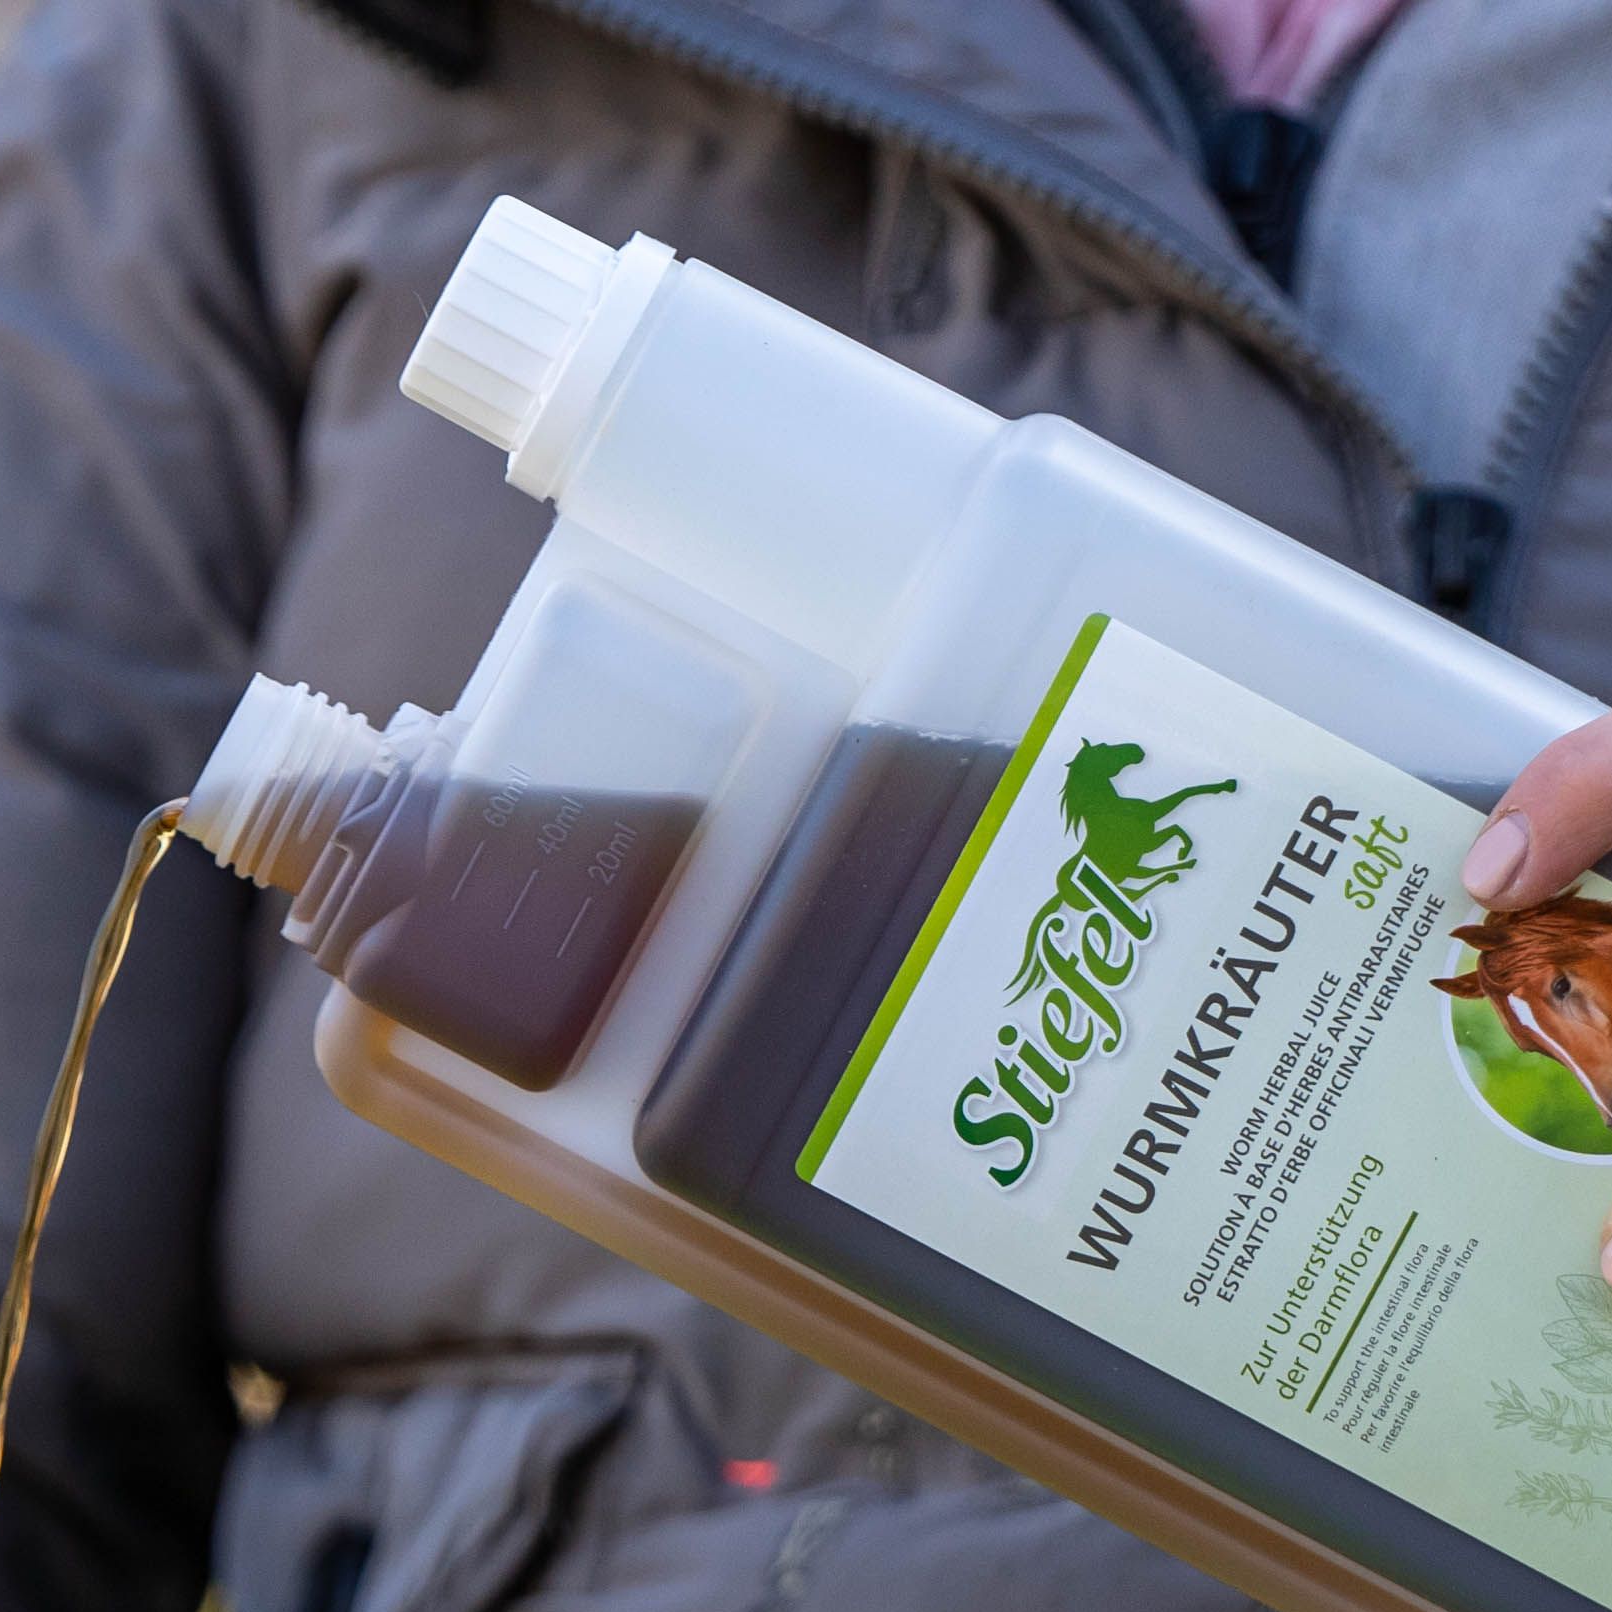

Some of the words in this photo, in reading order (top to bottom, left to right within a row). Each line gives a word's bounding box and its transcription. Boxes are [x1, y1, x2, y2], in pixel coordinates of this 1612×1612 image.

[483, 762, 531, 828] 60ml
[537, 794, 584, 855] 40ml
[587, 817, 637, 886] 20ml
[1343, 814, 1409, 910] saft
[953, 860, 1153, 1188] Stiefel
[1065, 794, 1360, 1271] WURMKRÄUTER
[1182, 1208, 1245, 1307] SOLUTION
[1232, 1192, 1256, 1210] À
[1244, 1136, 1284, 1190] BASE
[1325, 862, 1429, 1043] ANTIPARASITAIRES
[1215, 1205, 1278, 1303] ESTRATTO
[1308, 1024, 1375, 1131] OFFICINALI
[1363, 892, 1446, 1022] VERMIFUGHE
[1218, 1106, 1268, 1175] WORM
[1257, 1030, 1312, 1106] HERBAL
[1301, 970, 1341, 1028] JUICE
[1239, 1338, 1278, 1385] Zur
[1265, 1153, 1384, 1335] Unterstützung
[1274, 1355, 1309, 1400] der
[1297, 1224, 1383, 1354] Darmflora
[1410, 1243, 1452, 1311] intestinale
[1321, 1408, 1340, 1423] To
[1333, 1358, 1366, 1408] support
[1359, 1335, 1379, 1358] the
[1373, 1273, 1411, 1335] intestinal
[1403, 1242, 1429, 1274] flora
[1359, 1421, 1378, 1444] Per
[1370, 1372, 1406, 1421] favorire
[1397, 1303, 1443, 1372] l'equilibrio
[1437, 1270, 1461, 1303] della
[1453, 1237, 1479, 1268] flora
[1382, 1343, 1398, 1358] la
[1389, 1311, 1416, 1342] flore
[1340, 1403, 1364, 1434] Pour
[1359, 1357, 1390, 1404] réguler
[1379, 1389, 1420, 1454] intestinale
